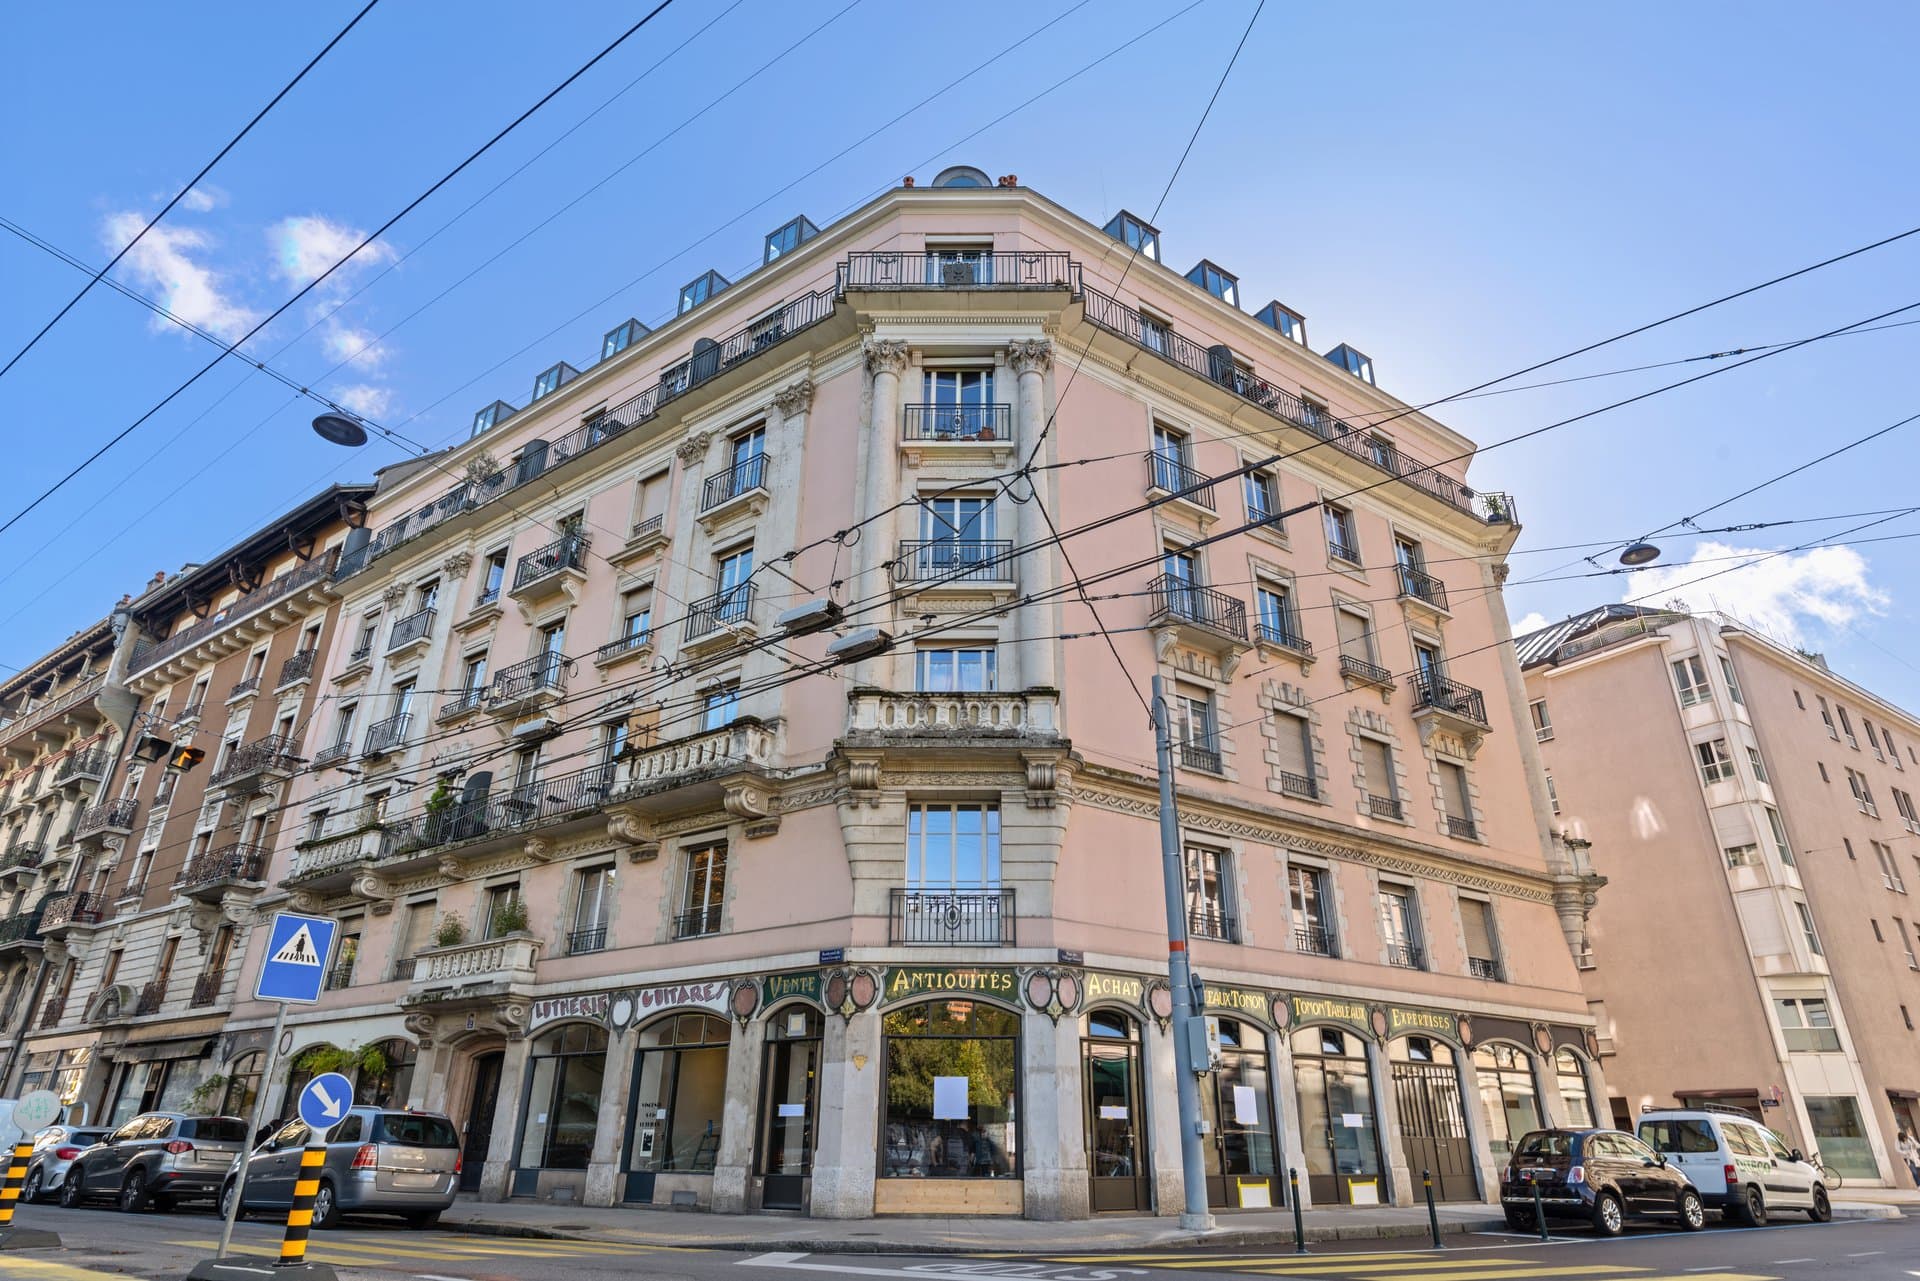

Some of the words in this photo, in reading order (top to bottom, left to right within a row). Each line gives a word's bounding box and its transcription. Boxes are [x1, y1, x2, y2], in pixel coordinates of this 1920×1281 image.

[535, 994, 608, 1018] LUTHERIE
[642, 982, 729, 1008] GUITARES
[902, 1262, 1150, 1281] STOP
